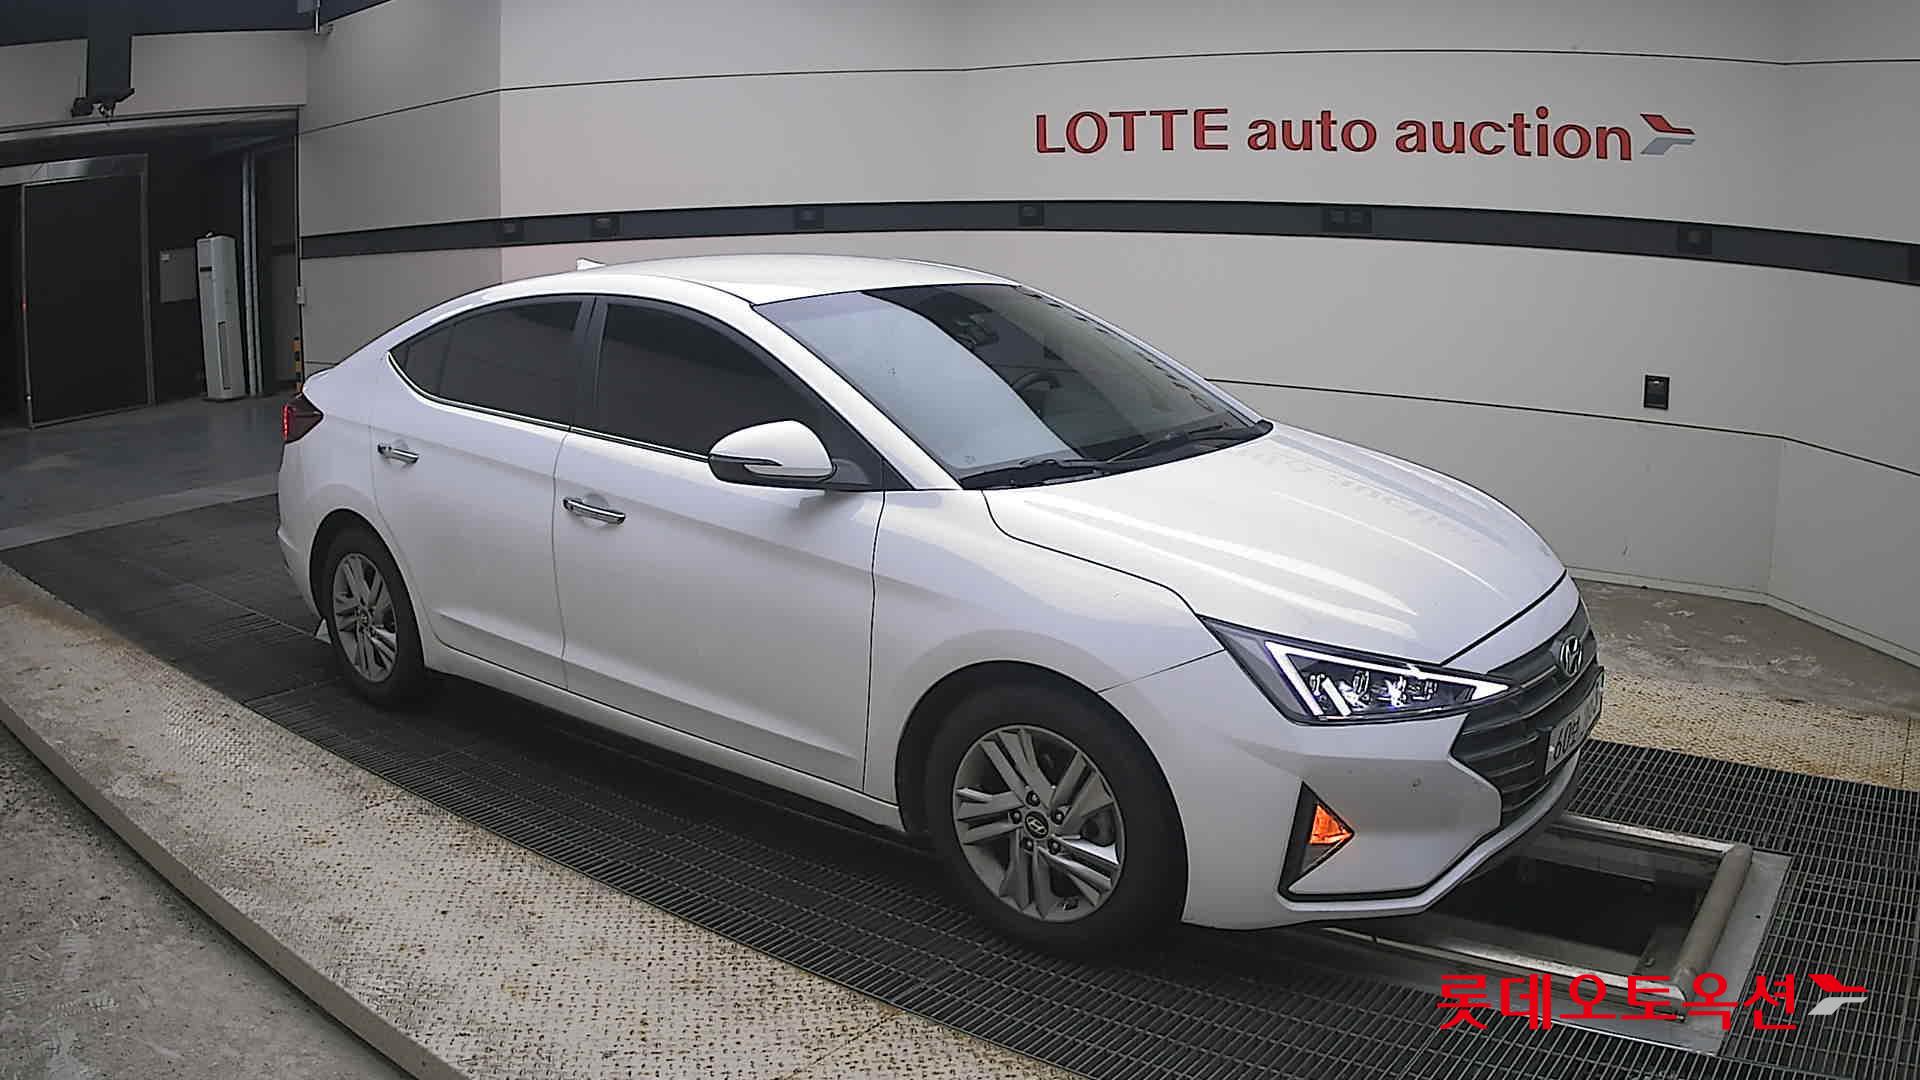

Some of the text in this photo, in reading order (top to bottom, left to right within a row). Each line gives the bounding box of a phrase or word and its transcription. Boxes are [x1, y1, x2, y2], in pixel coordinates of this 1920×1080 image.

[1035, 105, 1632, 161] LOTTE auto auction
